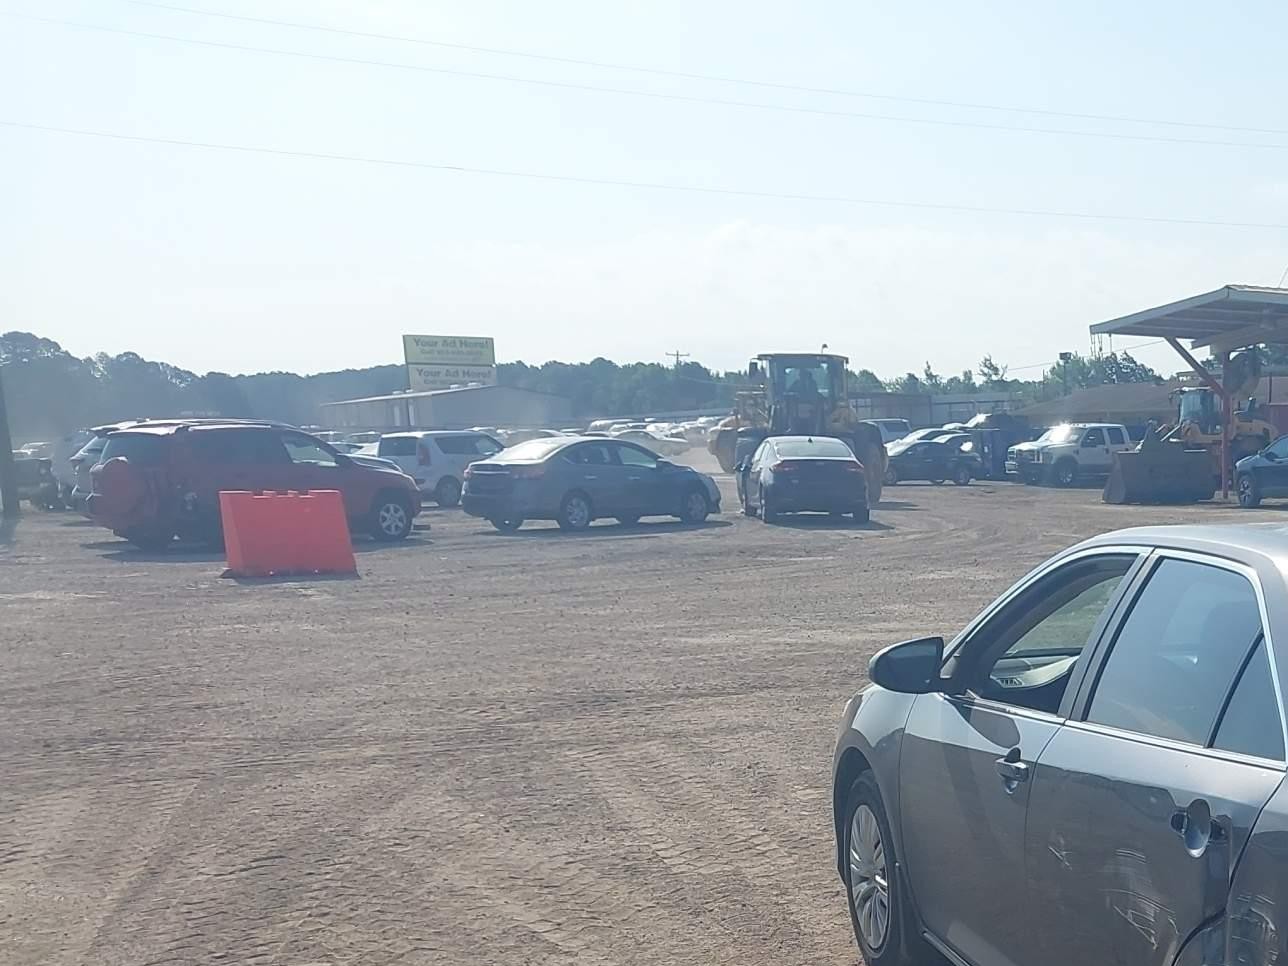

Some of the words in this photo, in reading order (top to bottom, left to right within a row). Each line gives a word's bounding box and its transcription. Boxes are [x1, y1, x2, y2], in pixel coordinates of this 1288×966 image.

[413, 338, 438, 348] Your
[441, 339, 457, 348] Ad
[459, 339, 489, 349] Here!
[416, 368, 442, 378] Your
[445, 369, 459, 378] Ad
[462, 370, 492, 379] Here!
